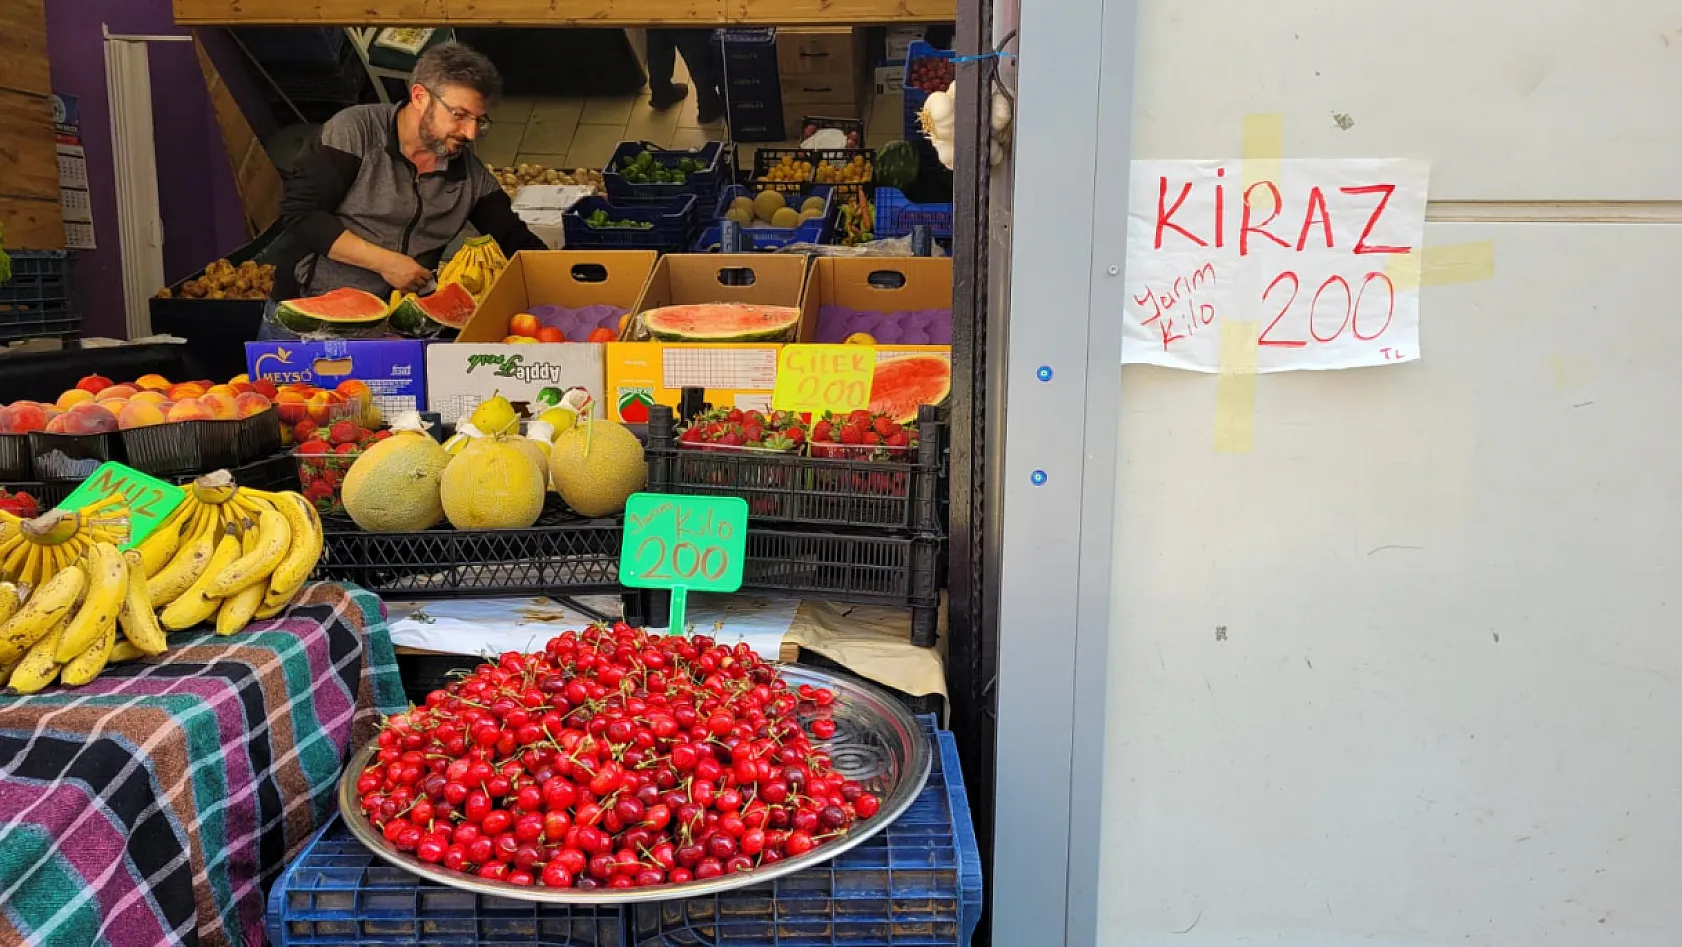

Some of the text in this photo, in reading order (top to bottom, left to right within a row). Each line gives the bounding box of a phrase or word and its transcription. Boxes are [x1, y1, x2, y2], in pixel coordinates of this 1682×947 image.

[1154, 167, 1412, 257] KİRAZ
[1257, 271, 1395, 345] 200
[513, 361, 562, 384] Apple
[1380, 347, 1405, 360] TL
[793, 375, 866, 408] 200
[635, 535, 729, 581] 200
